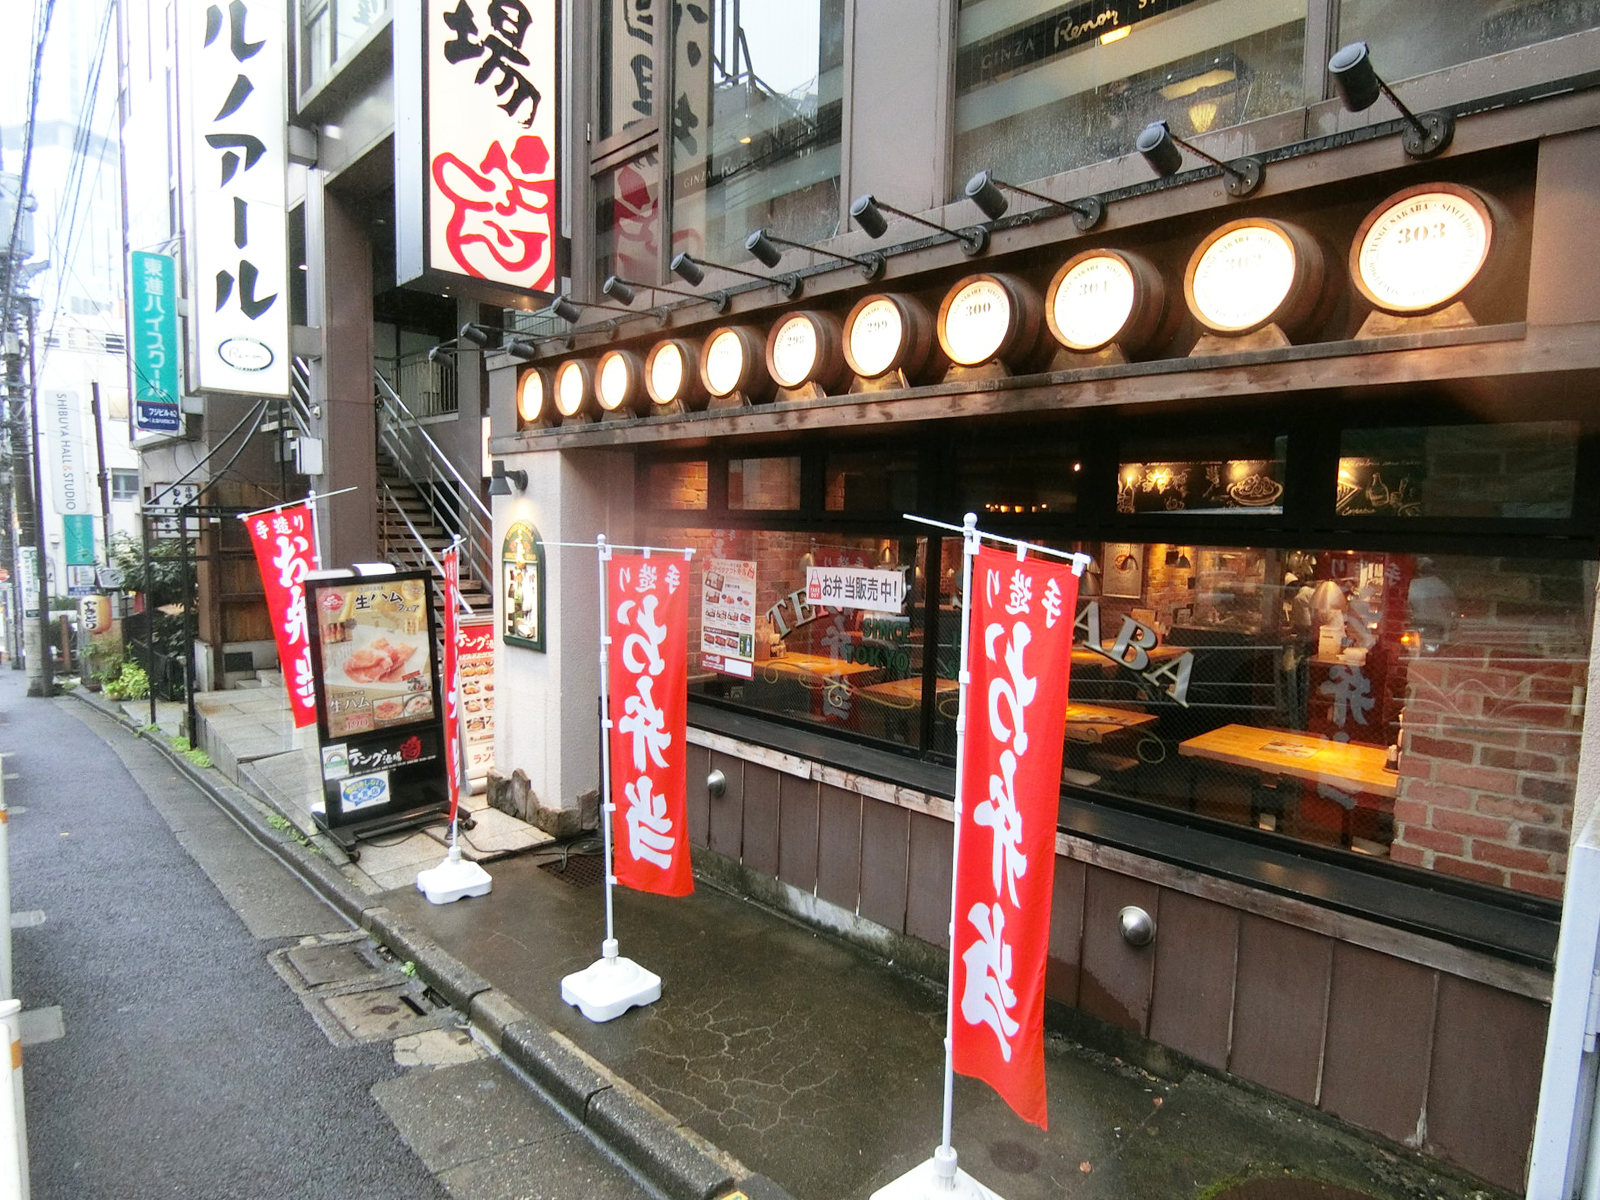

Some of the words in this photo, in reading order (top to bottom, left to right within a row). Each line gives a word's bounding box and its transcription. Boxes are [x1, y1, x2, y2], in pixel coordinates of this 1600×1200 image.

[203, 0, 279, 320] ルノアール
[1398, 222, 1446, 244] 303
[965, 302, 991, 316] 300
[144, 257, 168, 397] 東進ハイスクール
[56, 393, 70, 437] SHIBUYA
[60, 440, 73, 464] HALL
[63, 472, 76, 511] STUDIO
[256, 515, 304, 539] 手造り
[355, 591, 403, 610] 生ハム
[863, 617, 911, 643] SINCE
[845, 643, 910, 671] TOKYO
[330, 696, 370, 713] 生ハム
[349, 748, 402, 767] テング酒場
